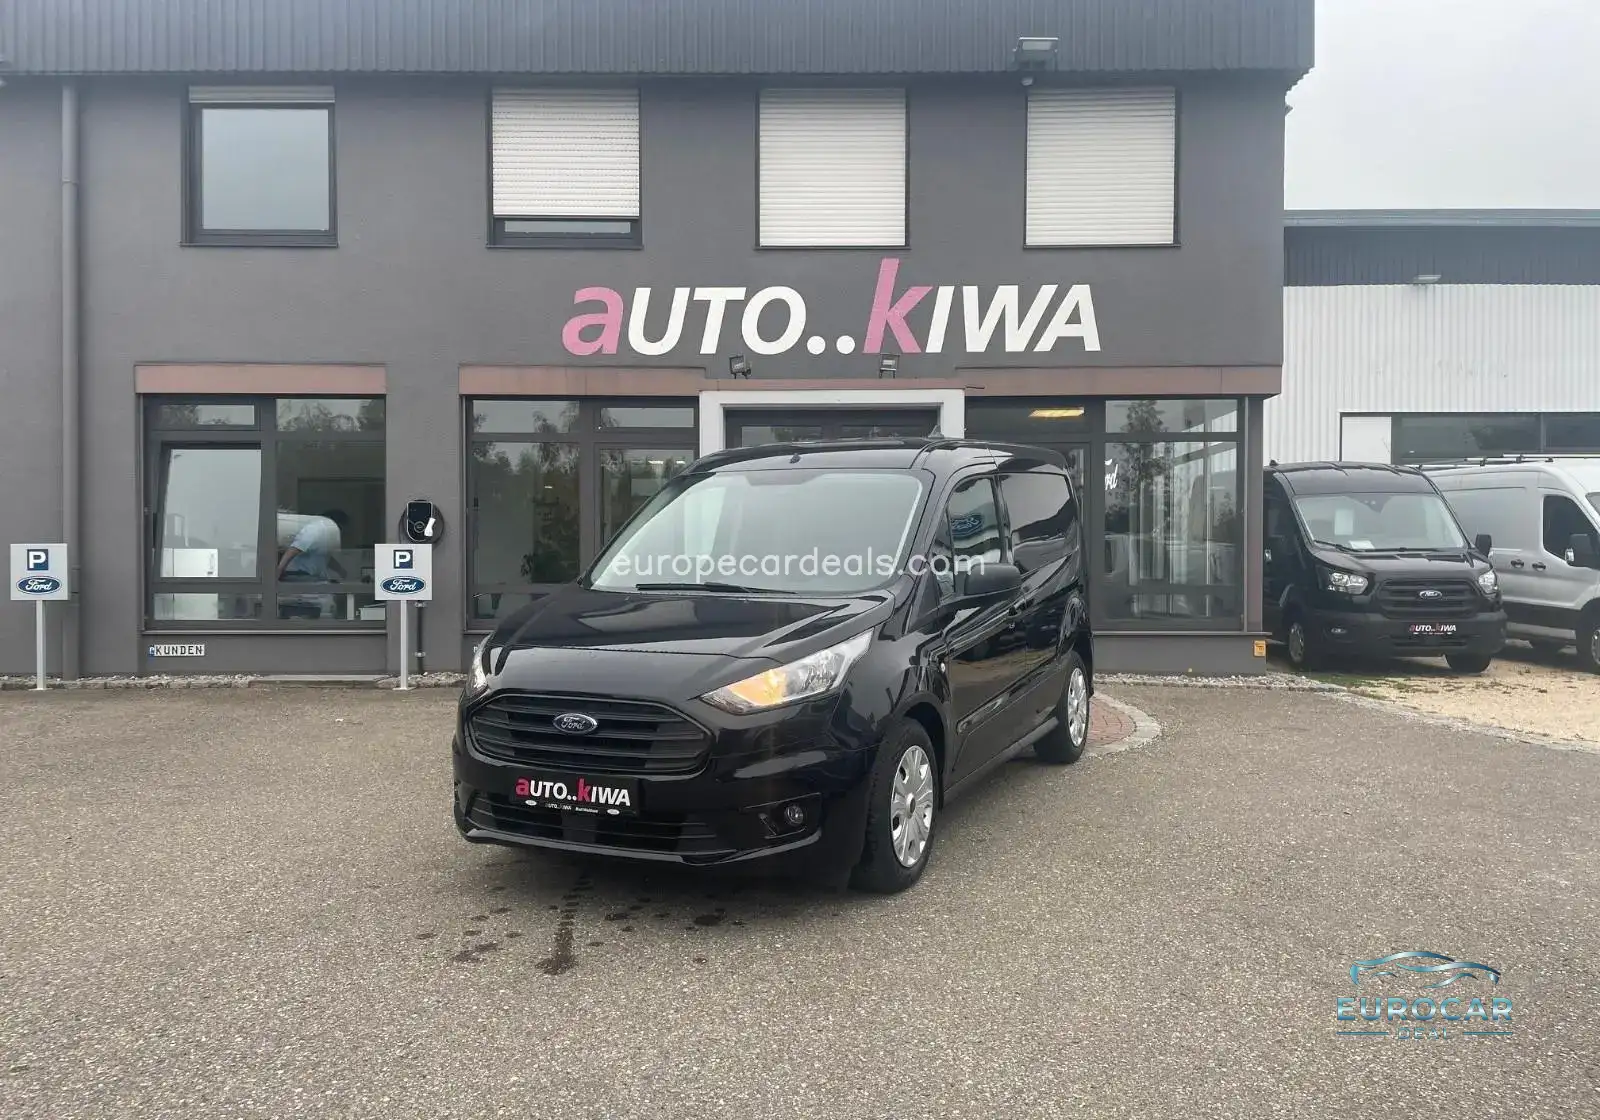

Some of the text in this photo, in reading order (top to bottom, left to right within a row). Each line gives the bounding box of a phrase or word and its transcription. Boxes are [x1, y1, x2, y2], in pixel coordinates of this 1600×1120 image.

[29, 551, 46, 569] P
[395, 551, 411, 567] P
[24, 579, 53, 591] Ford
[389, 579, 417, 591] Ford
[155, 645, 202, 656] KUNDEN
[560, 716, 586, 730] Ford
